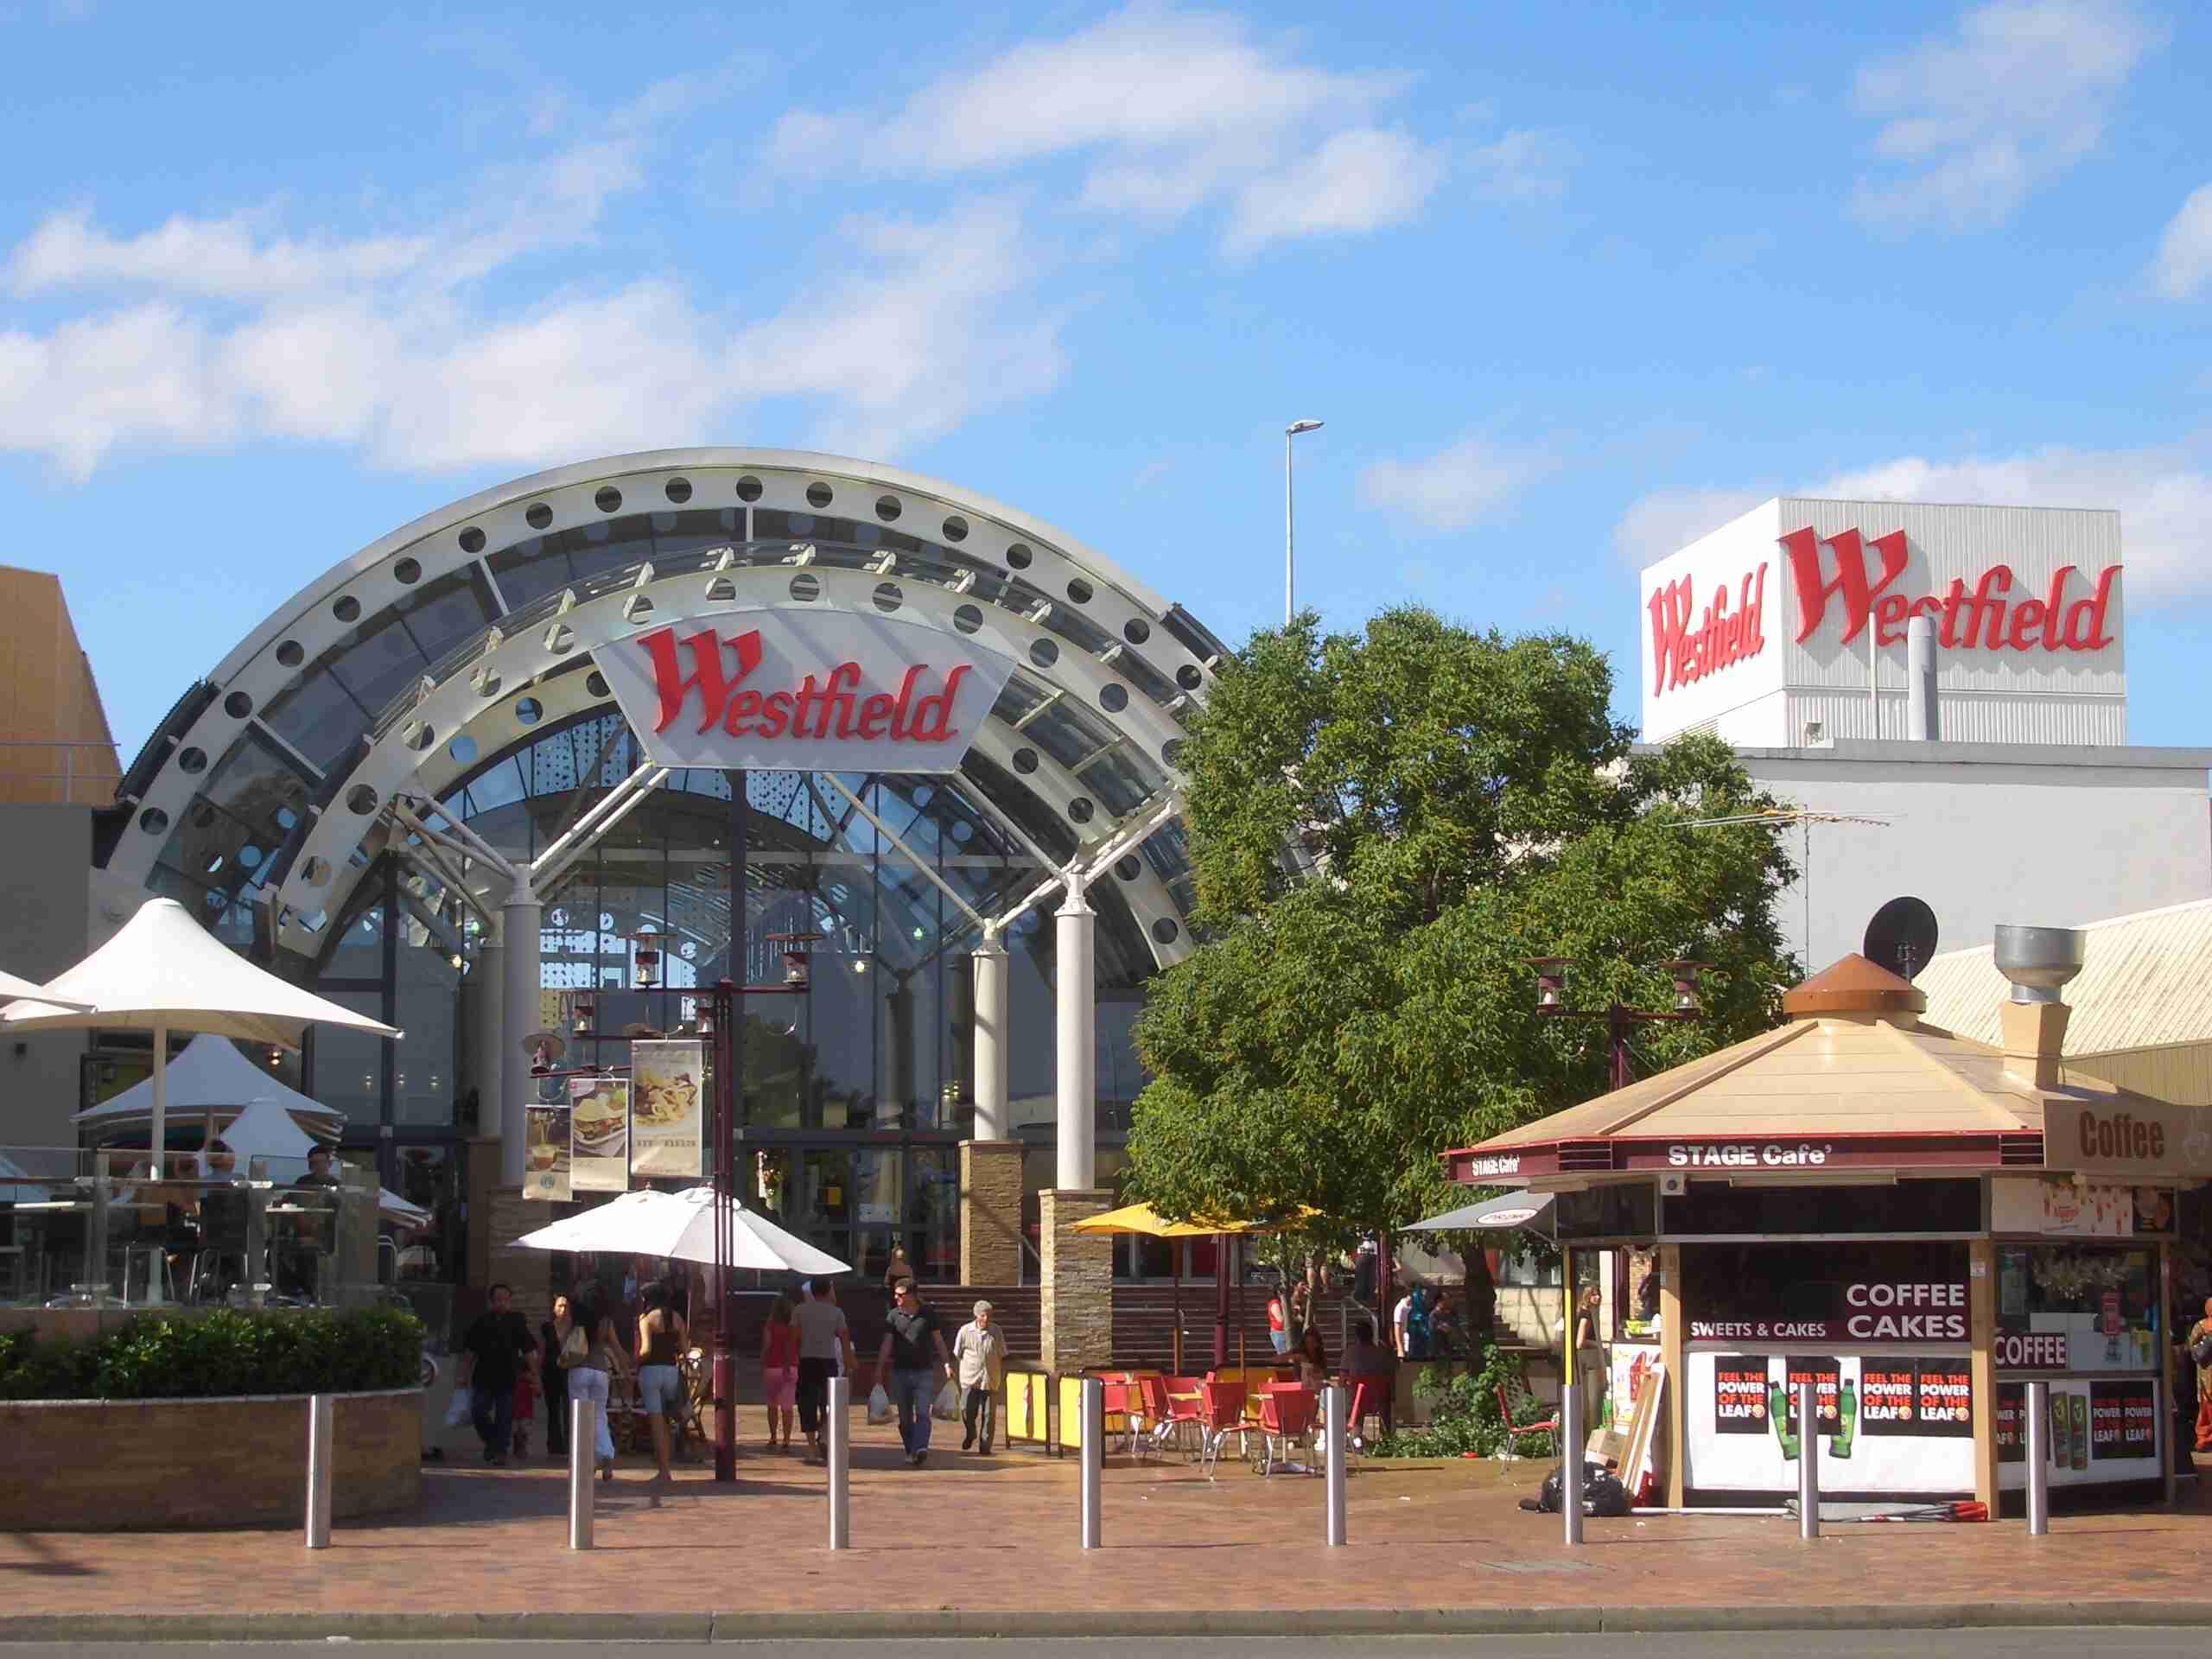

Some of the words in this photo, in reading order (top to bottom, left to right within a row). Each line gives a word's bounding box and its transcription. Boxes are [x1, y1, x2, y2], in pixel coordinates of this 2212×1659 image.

[1647, 562, 1768, 698] Westfield
[637, 626, 972, 742] Westfield
[2080, 1110, 2164, 1160] Coffee
[1669, 1144, 1758, 1166] STAGE
[1471, 1156, 1498, 1176] STAGE
[1846, 1283, 1965, 1306] COFFEE
[1690, 1322, 1752, 1338] SWEETS
[1756, 1323, 1769, 1338] &
[1773, 1322, 1827, 1338] CAKES
[1846, 1313, 1965, 1338] CAKES
[1993, 1336, 2066, 1364] COFFEE
[1719, 1372, 1741, 1382] FEEL
[1744, 1372, 1764, 1382] THE
[1789, 1373, 1812, 1382] FEEL
[1815, 1373, 1837, 1382] THE
[1864, 1373, 1887, 1383] FEEL
[1890, 1373, 1911, 1383] THE
[1920, 1375, 1944, 1384] FEEL
[1947, 1375, 1968, 1384] THE
[1718, 1382, 1765, 1394] POWER
[1863, 1383, 1912, 1395] POWER
[1920, 1384, 1969, 1395] POWER
[1719, 1394, 1738, 1404] OF
[1741, 1394, 1764, 1404] THE
[1818, 1394, 1836, 1405] HE
[1865, 1395, 1883, 1406] OF
[1887, 1395, 1911, 1406] THE
[1921, 1396, 1939, 1407] OF
[1944, 1396, 1968, 1407] THE
[1719, 1404, 1752, 1418] LEAF
[1864, 1407, 1898, 1420] LEAF
[1920, 1407, 1956, 1421] LEAF
[2124, 1408, 2152, 1418] POWER
